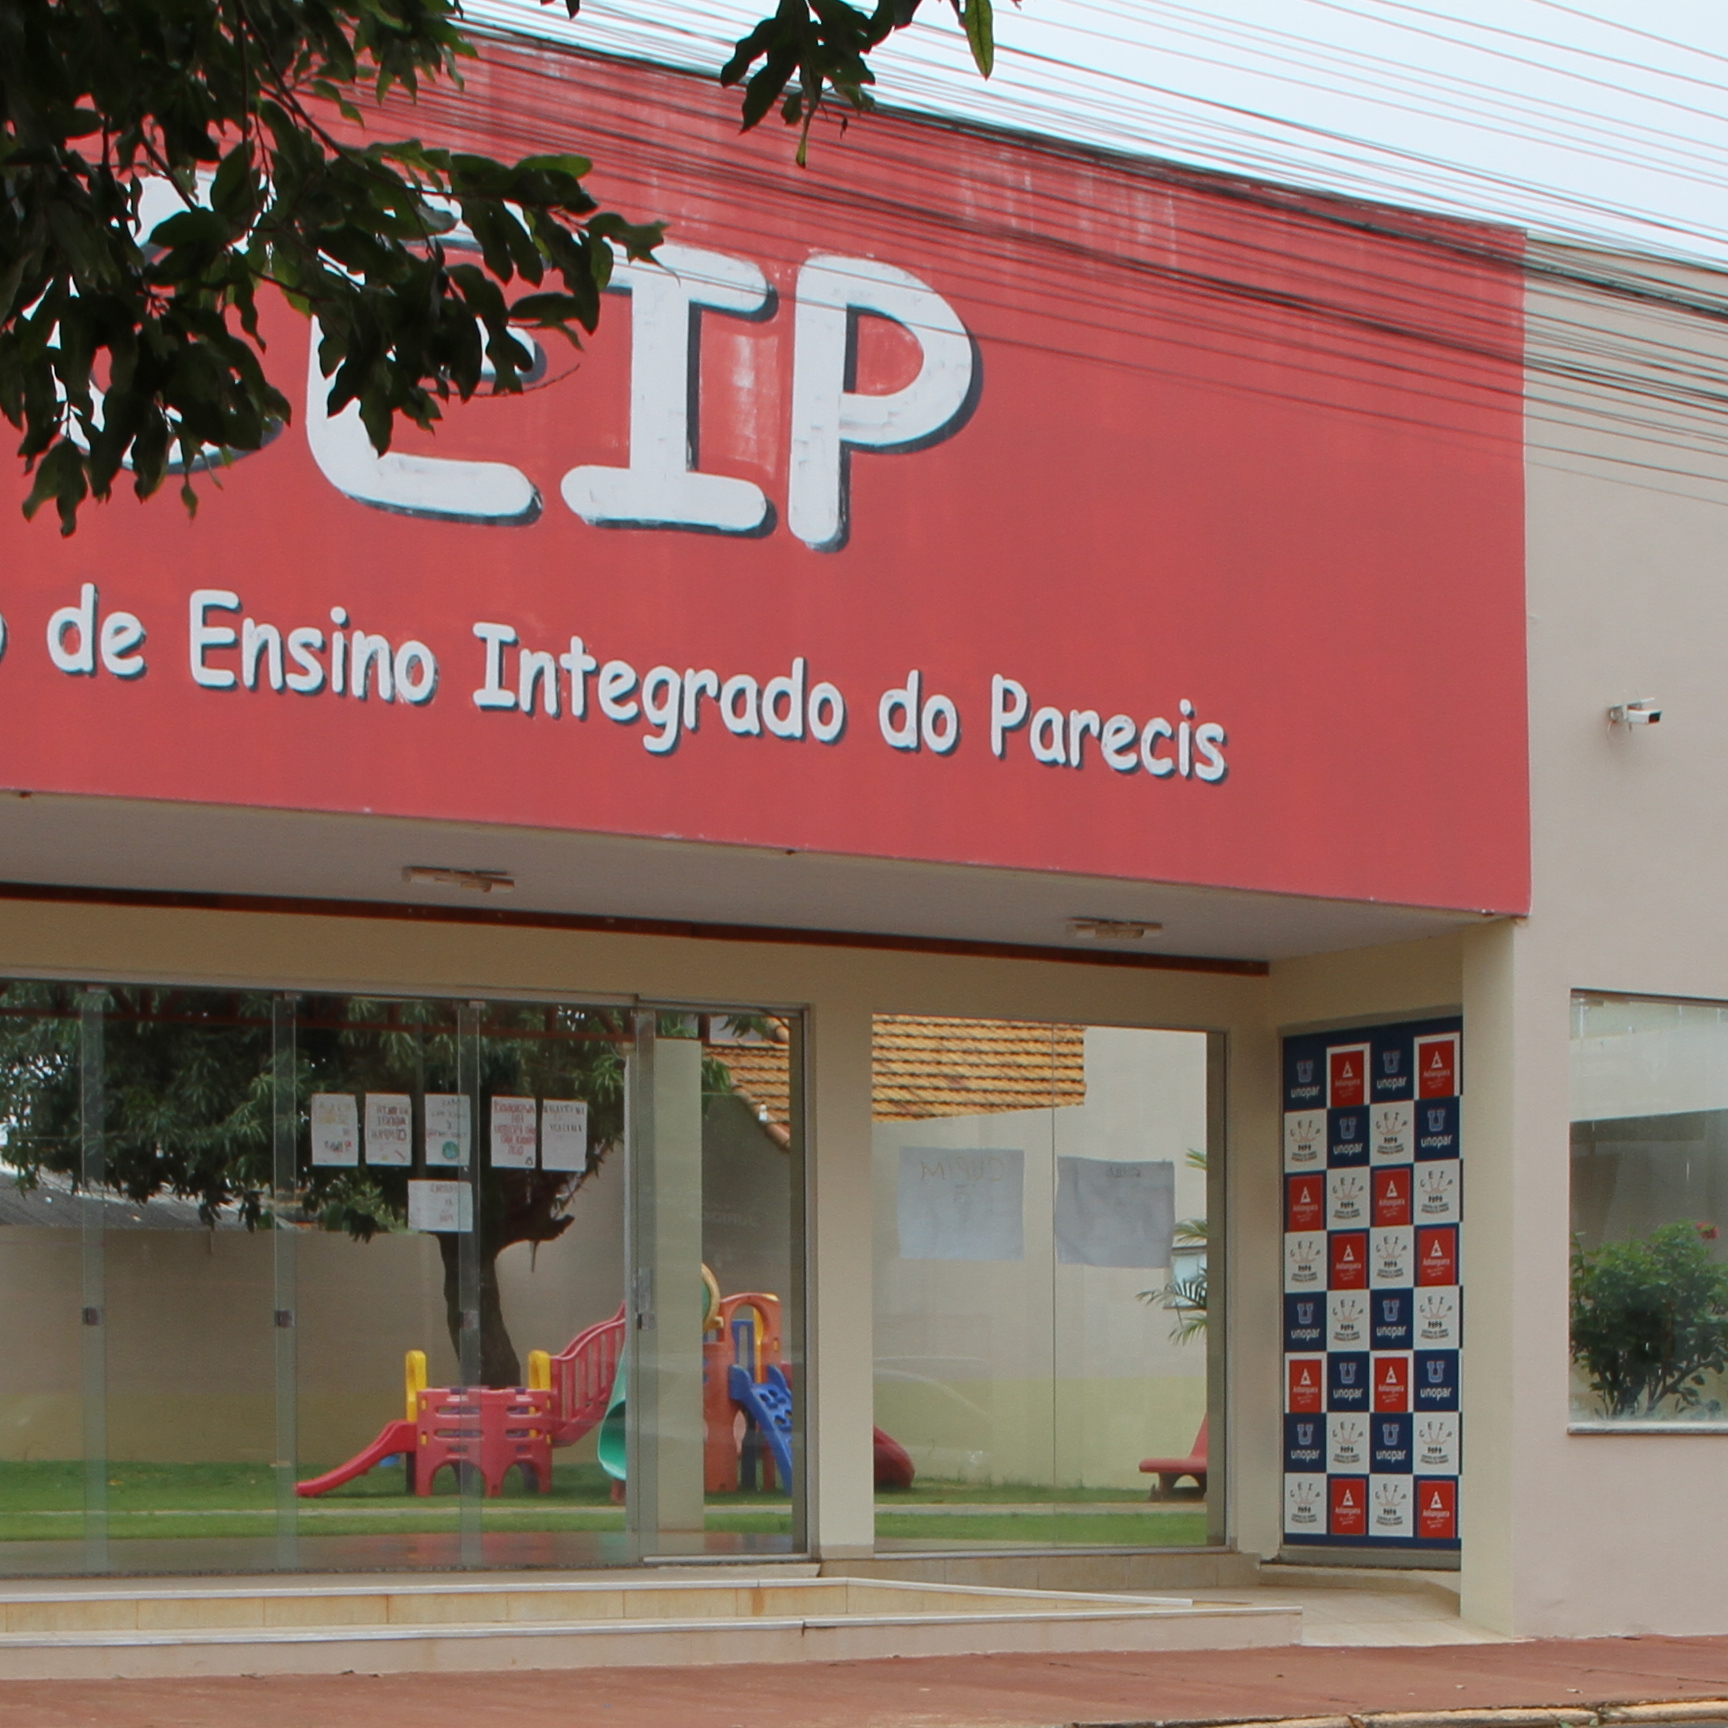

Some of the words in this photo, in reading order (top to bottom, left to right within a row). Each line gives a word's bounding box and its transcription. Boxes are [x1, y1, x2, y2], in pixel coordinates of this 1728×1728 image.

[47, 582, 145, 676] de
[190, 589, 438, 704] Ensino
[473, 621, 846, 755] Integrado
[878, 668, 958, 753] do
[991, 673, 1228, 781] Parecis
[1377, 1077, 1406, 1090] unopar
[1291, 1086, 1319, 1099] unopar
[1421, 1135, 1452, 1149] unopar
[1333, 1143, 1363, 1156] unopar
[1291, 1328, 1320, 1341] unopar
[1377, 1325, 1406, 1338] unopar
[1333, 1388, 1362, 1401] unopar
[1420, 1387, 1451, 1400] unopar
[1291, 1450, 1319, 1462] unopar
[1376, 1450, 1406, 1462] unopar
